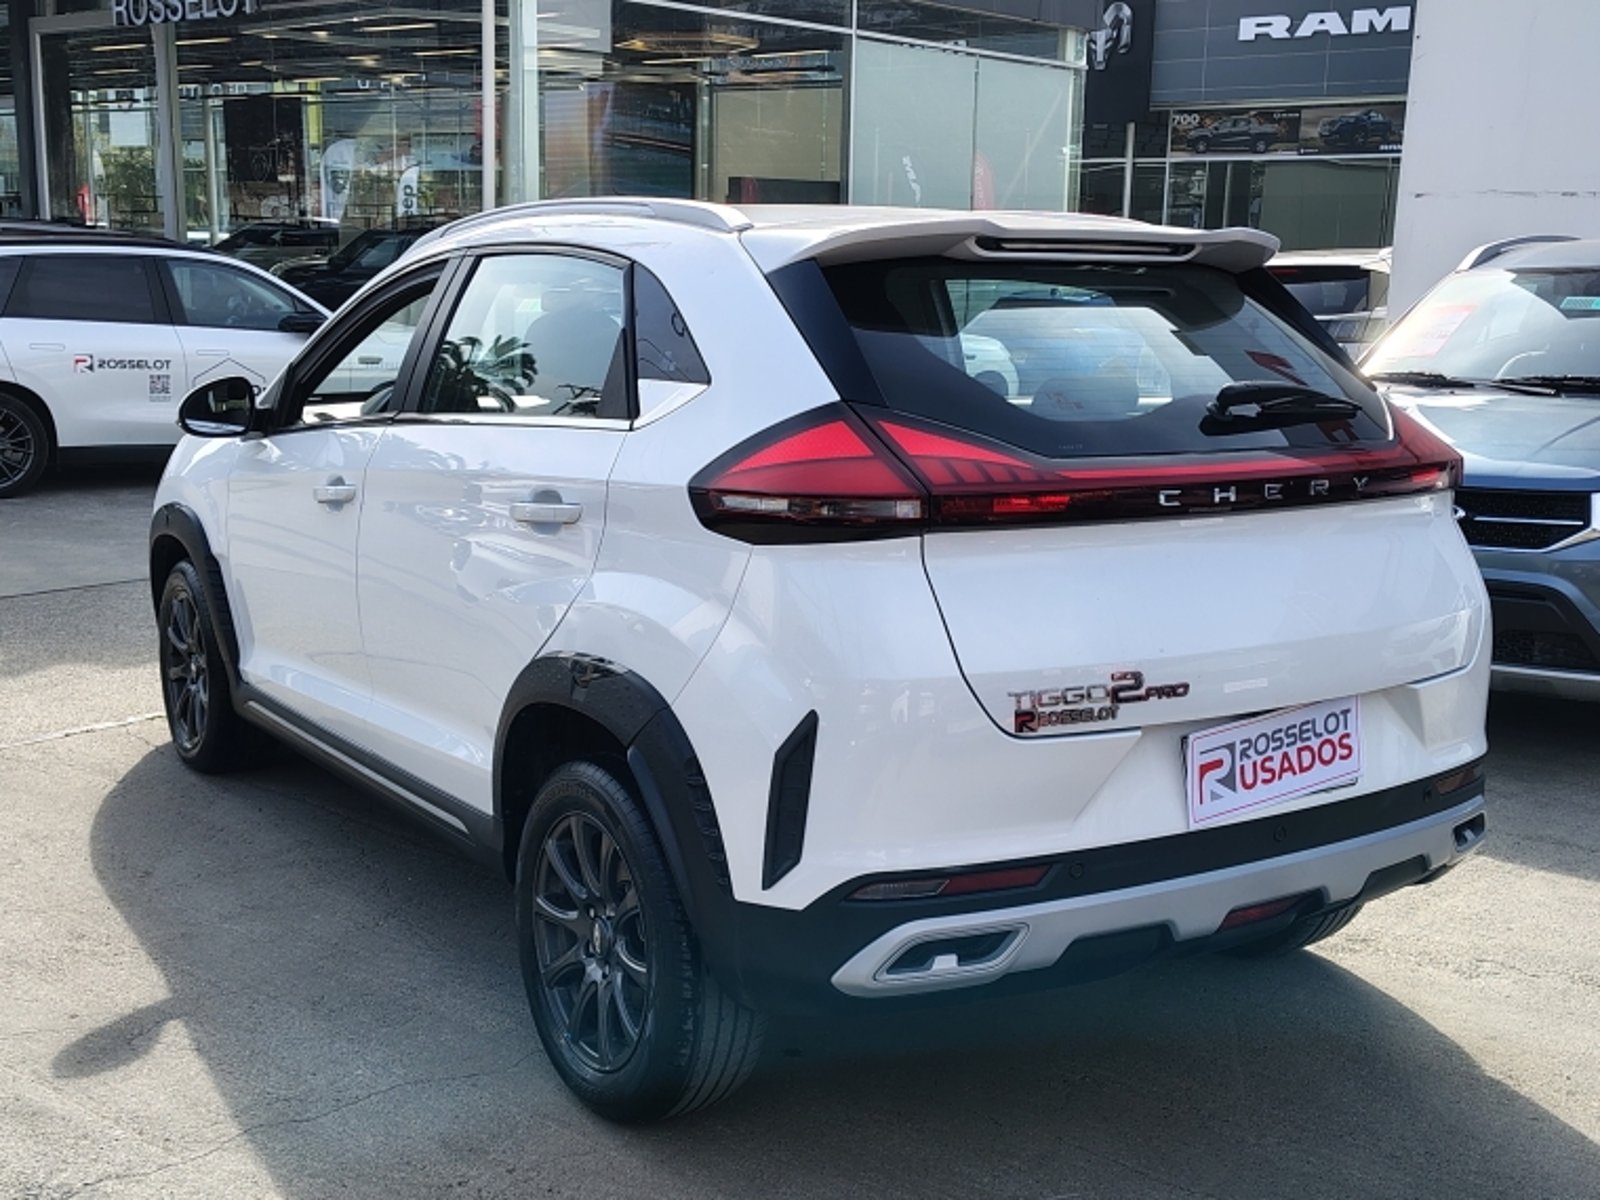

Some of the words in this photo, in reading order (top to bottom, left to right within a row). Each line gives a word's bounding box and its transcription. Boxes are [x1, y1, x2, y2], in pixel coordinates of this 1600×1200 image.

[1238, 6, 1411, 41] RAM
[1172, 113, 1200, 126] 700
[97, 359, 171, 370] ROSSELOT
[1159, 477, 1368, 506] CHERY
[1239, 708, 1351, 762] ROSSELOT
[1239, 732, 1353, 790] USADOS
